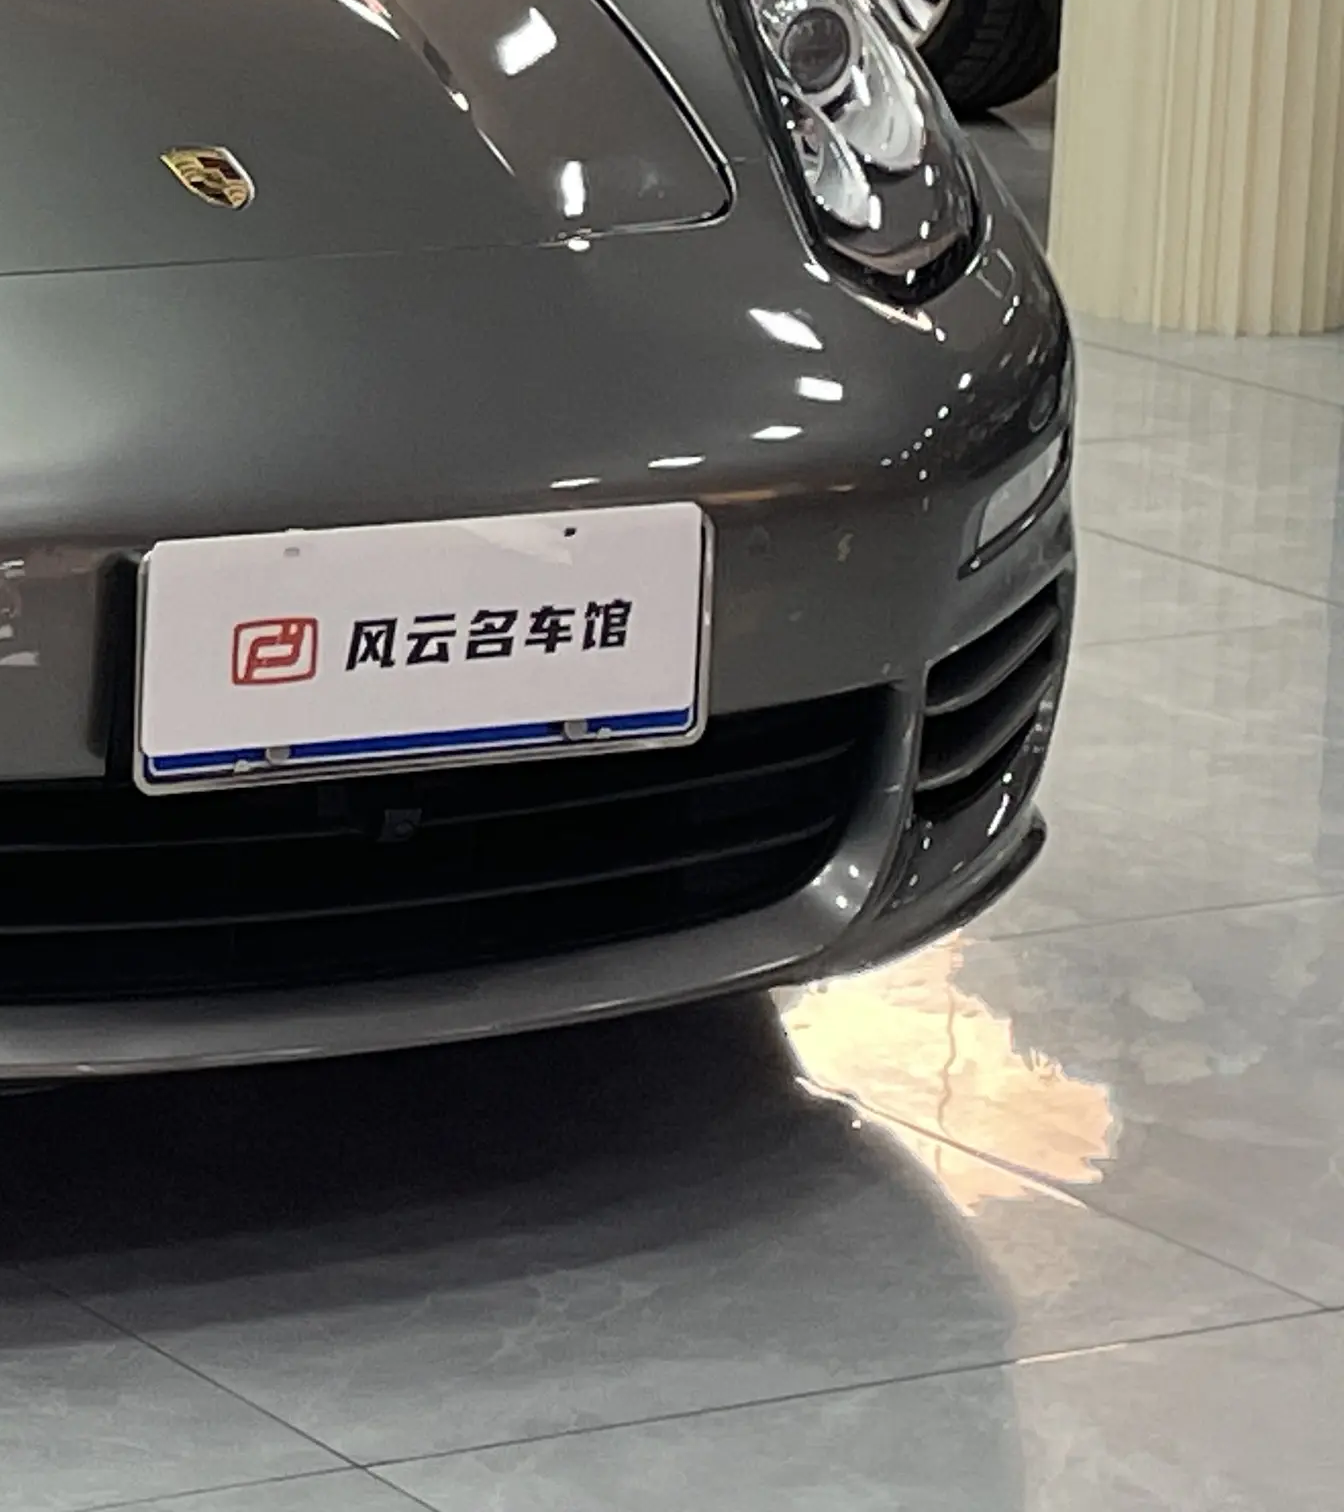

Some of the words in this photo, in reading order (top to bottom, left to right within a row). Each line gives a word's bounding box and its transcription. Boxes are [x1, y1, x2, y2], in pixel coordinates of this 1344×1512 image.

[345, 599, 632, 672] 风云名车馆
